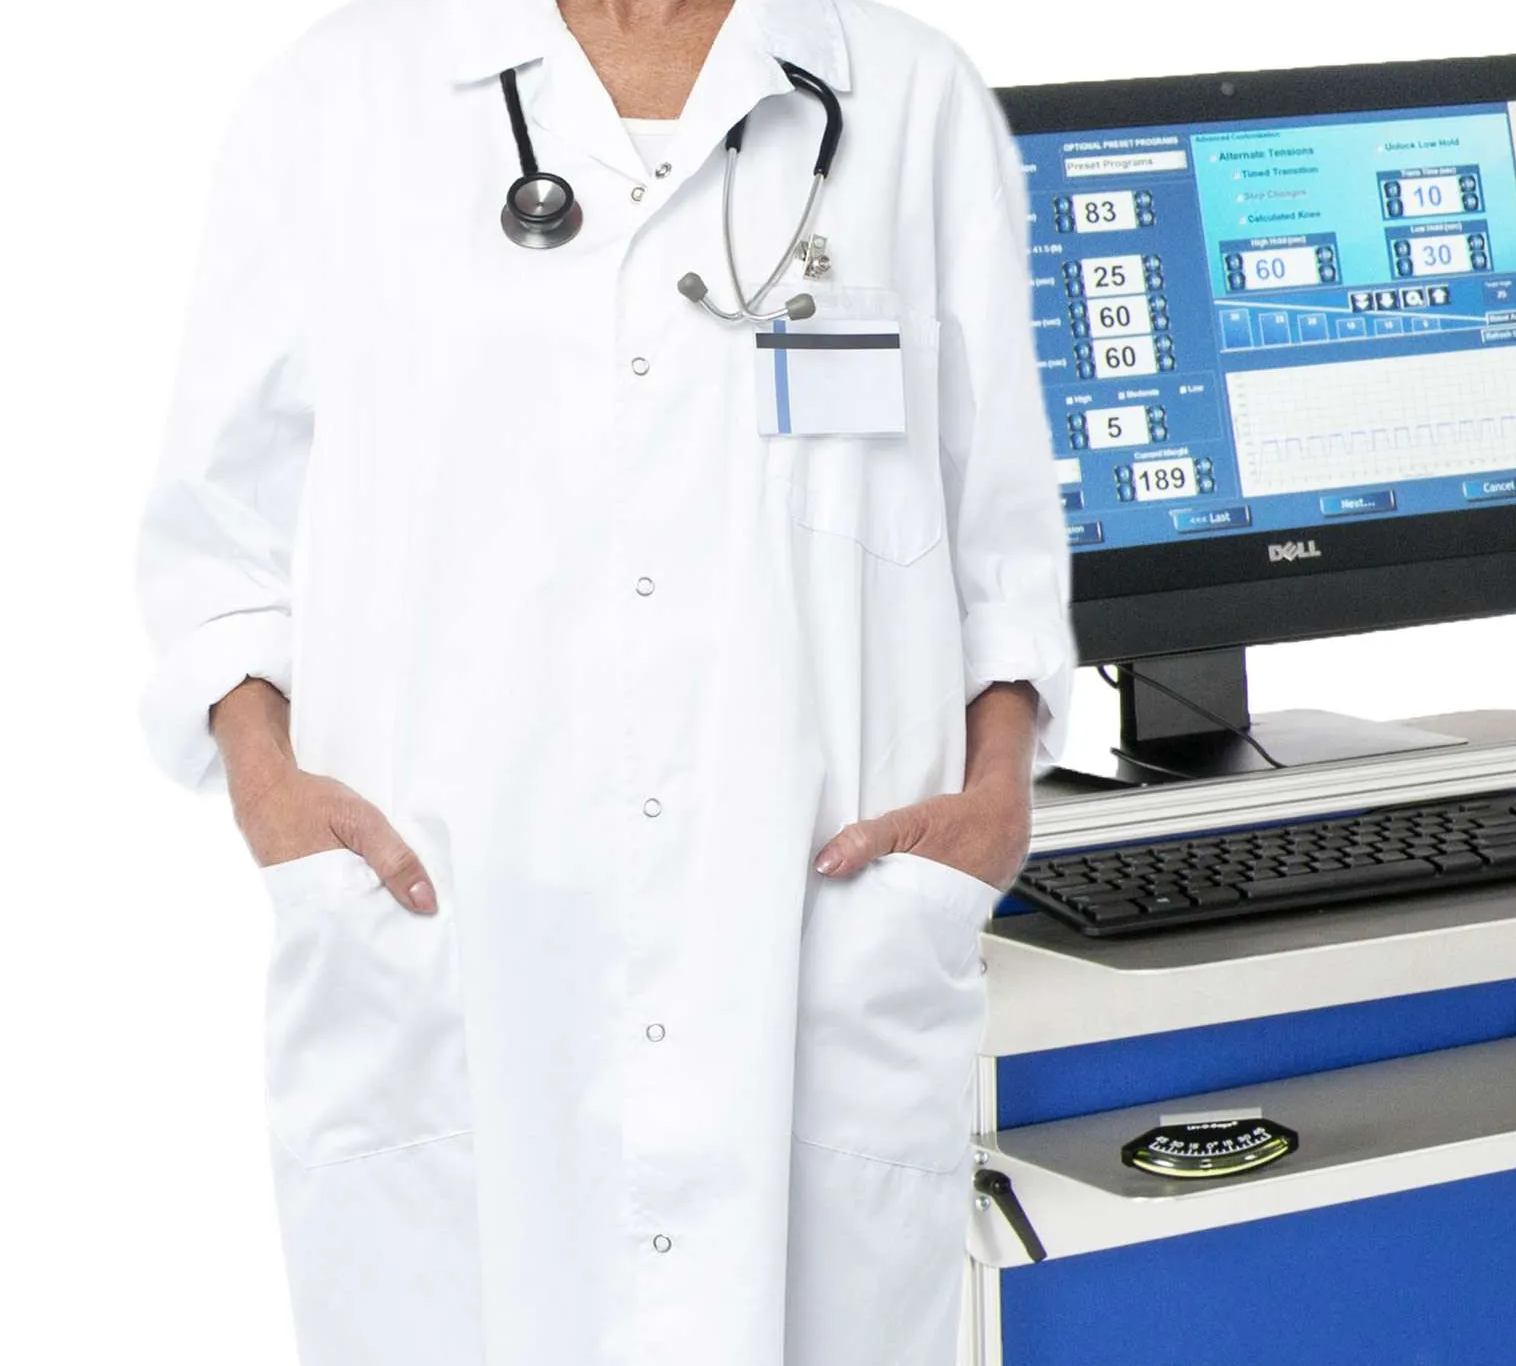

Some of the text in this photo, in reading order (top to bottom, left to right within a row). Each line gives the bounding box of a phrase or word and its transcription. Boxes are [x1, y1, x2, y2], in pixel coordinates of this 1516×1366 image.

[1067, 160, 1100, 171] Preset
[1219, 146, 1315, 162] Alternate Tensions
[1413, 185, 1442, 208] 10
[1085, 201, 1117, 224] 83
[1423, 244, 1452, 267] 30
[1093, 265, 1126, 288] 25
[1255, 257, 1286, 280] 60
[1099, 305, 1131, 328] 60
[1105, 345, 1137, 369] 60
[1107, 417, 1122, 438] 5
[1139, 467, 1185, 492] 189
[1483, 481, 1516, 493] Cancel
[1209, 511, 1231, 524] Last
[1268, 540, 1322, 562] DELL
